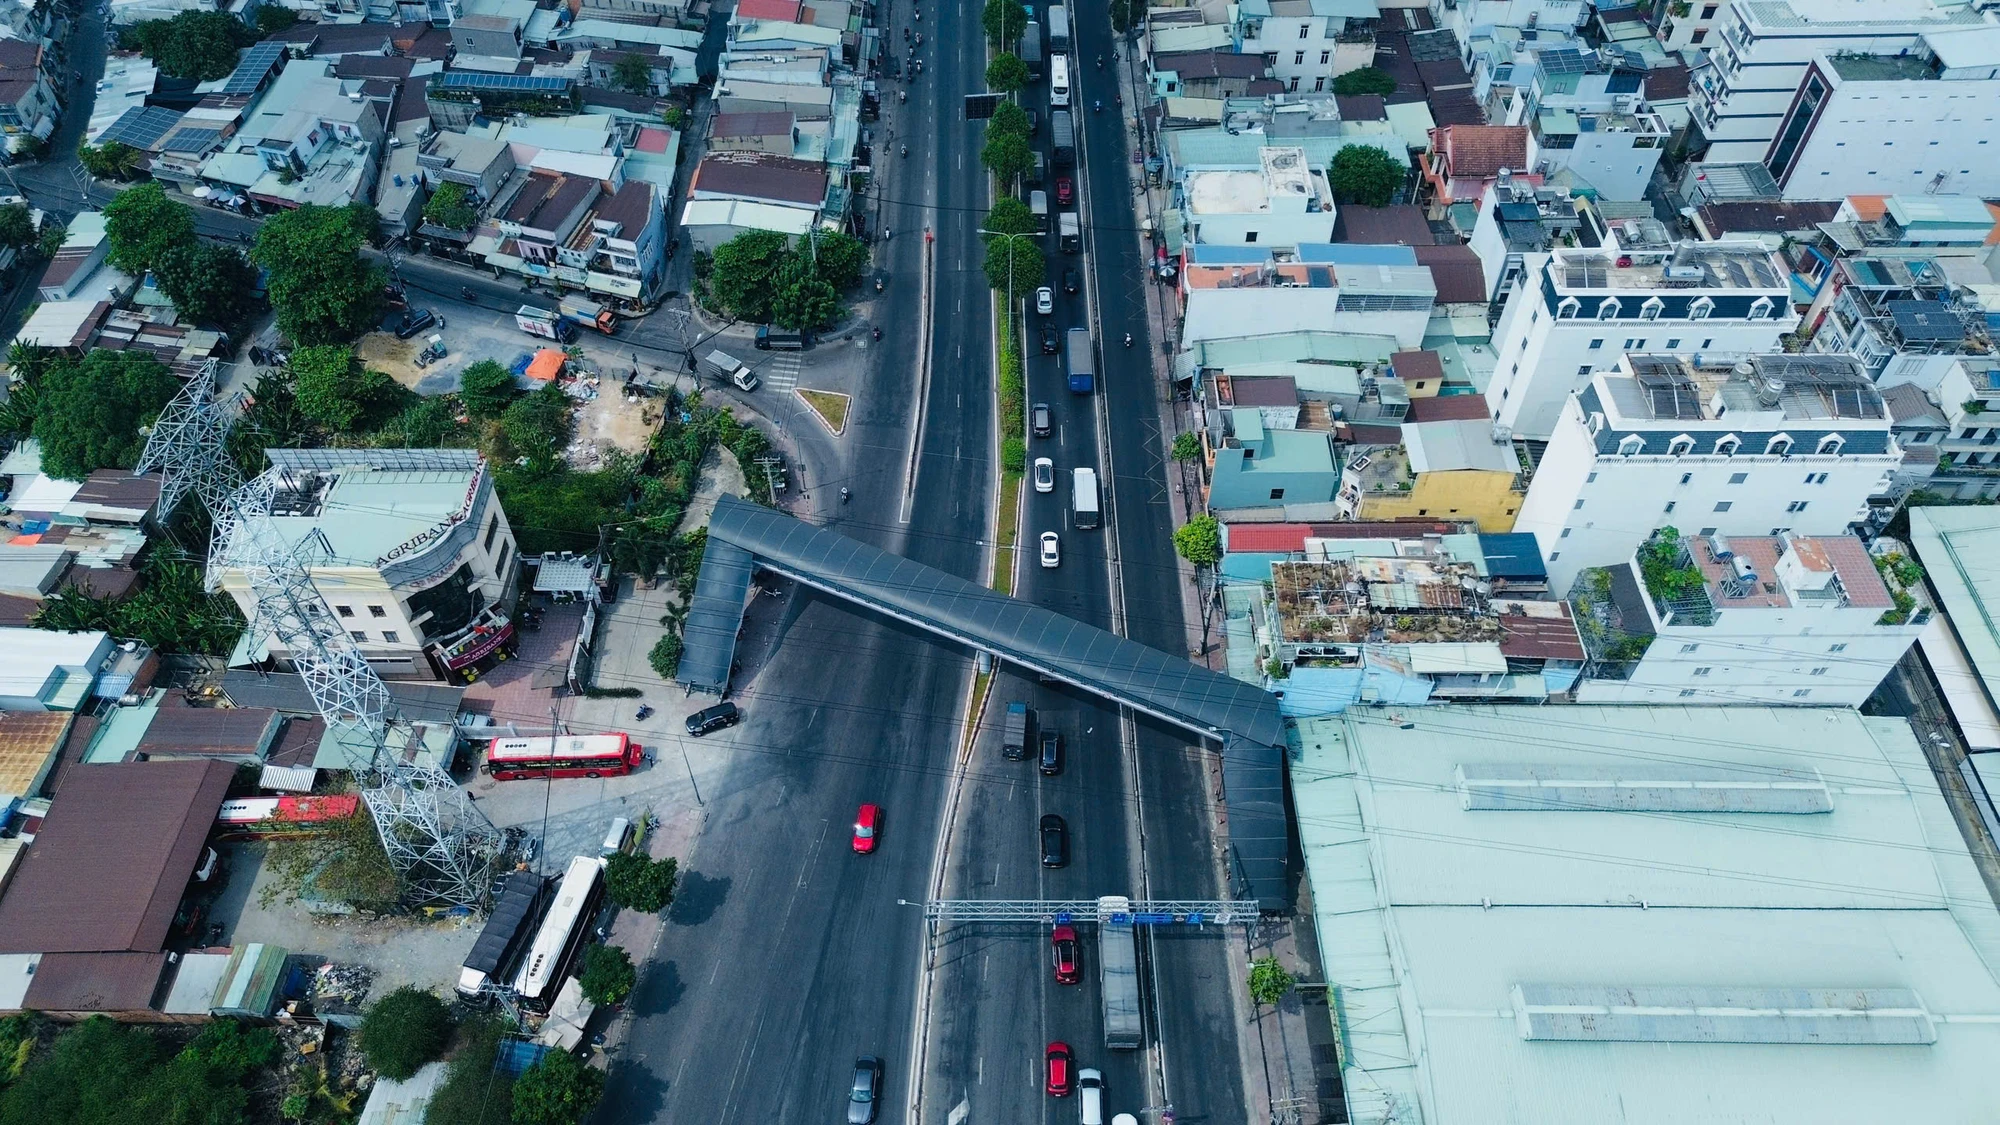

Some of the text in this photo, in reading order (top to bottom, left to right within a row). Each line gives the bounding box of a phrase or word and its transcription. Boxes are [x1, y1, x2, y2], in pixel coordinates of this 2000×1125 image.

[462, 450, 486, 520] AGRIBANK
[376, 511, 464, 568] AGRIBANK
[471, 635, 503, 659] AGRIBANK
